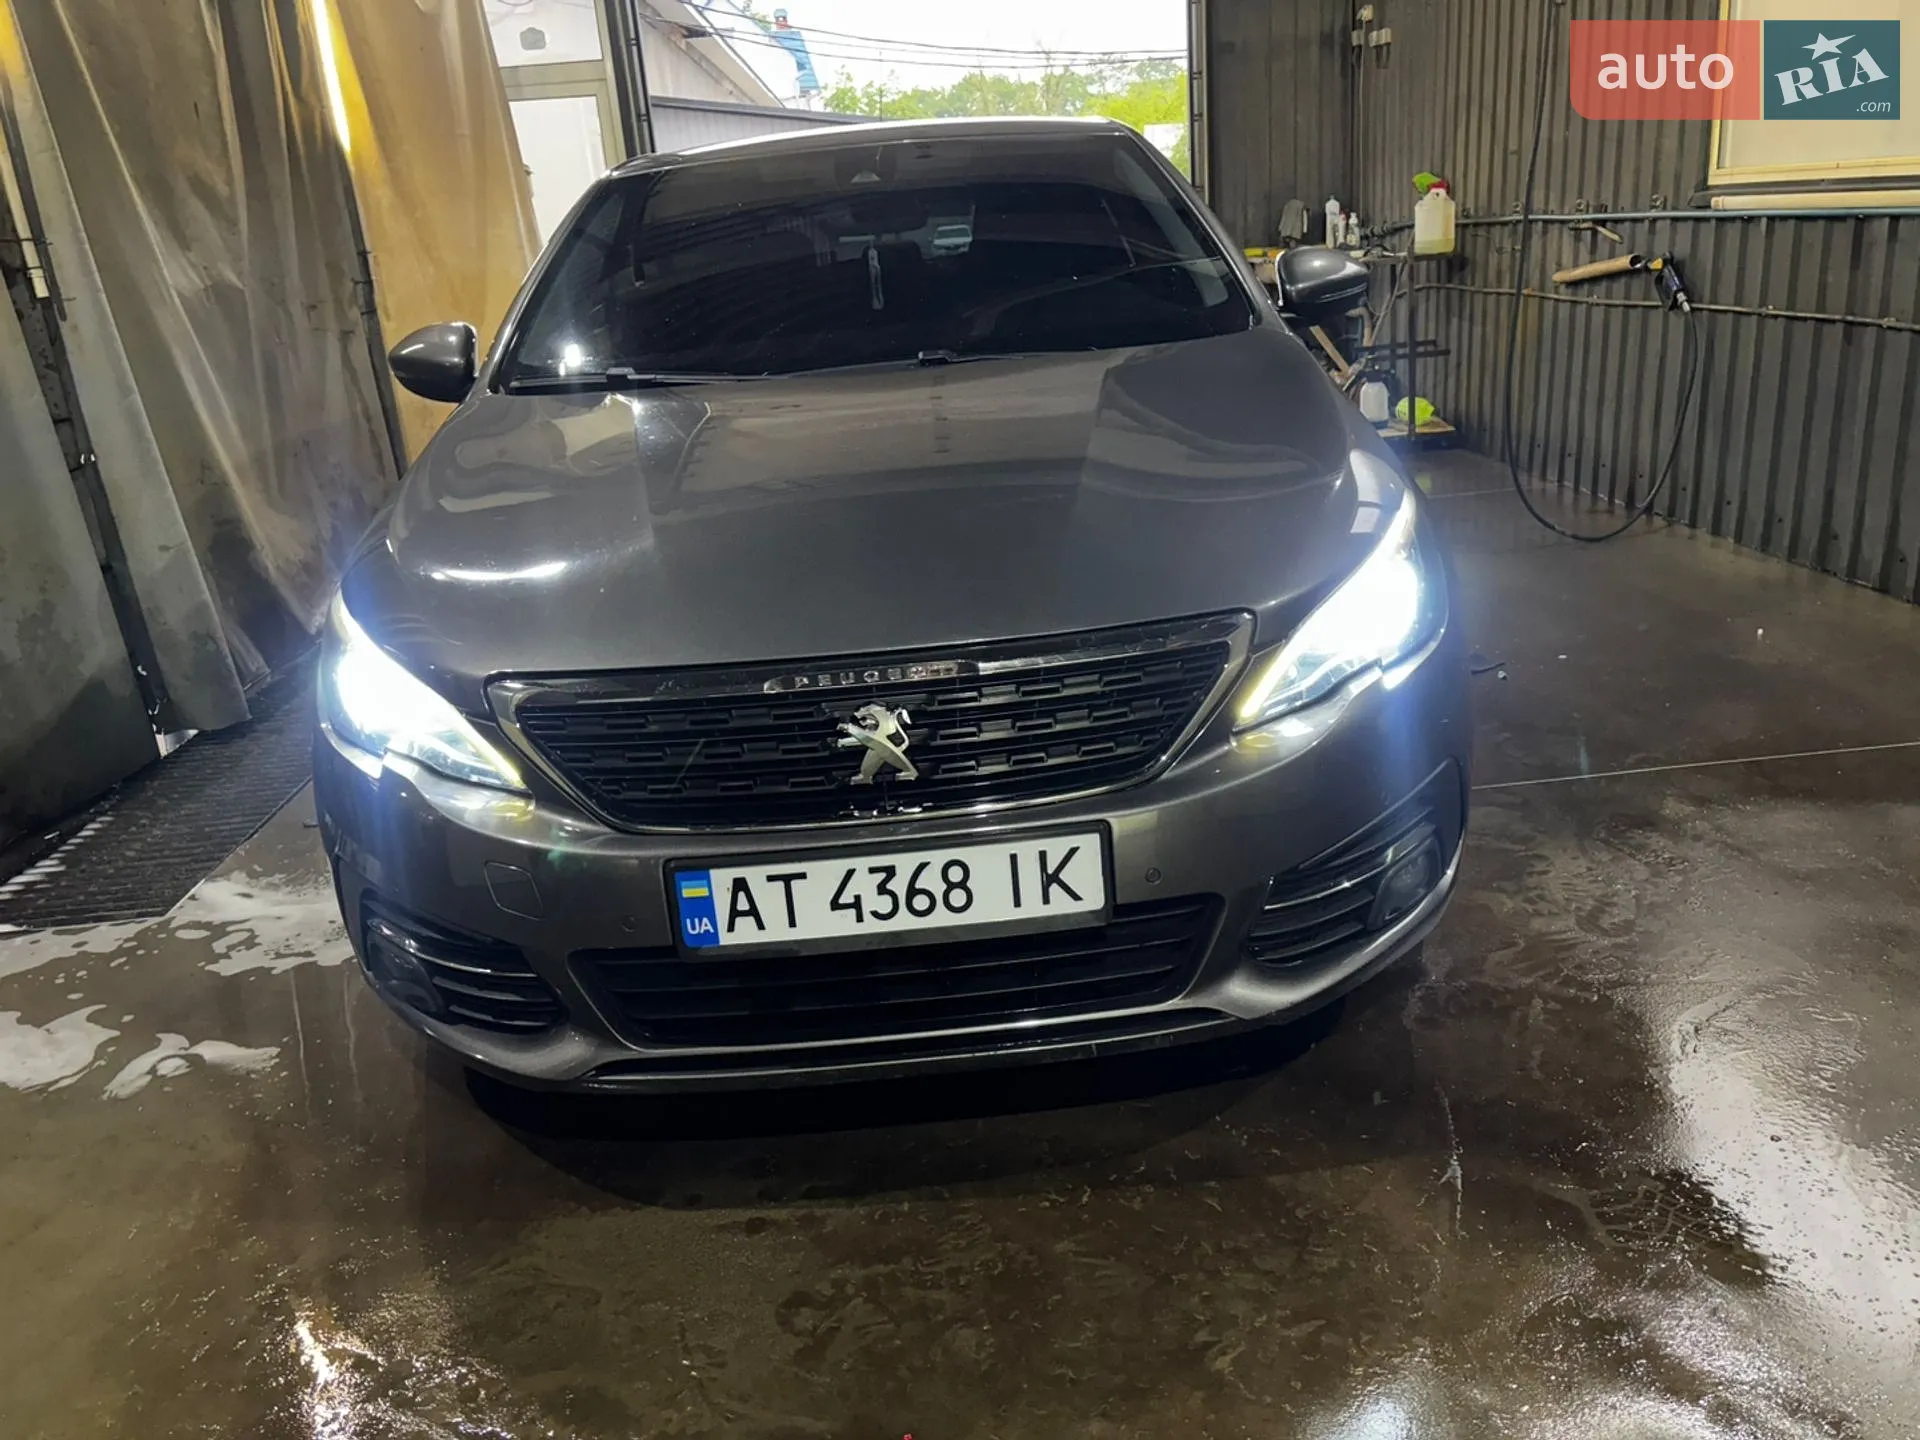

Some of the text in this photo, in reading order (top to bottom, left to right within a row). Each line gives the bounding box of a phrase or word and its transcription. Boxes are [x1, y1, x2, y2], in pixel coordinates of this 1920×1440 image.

[726, 846, 1084, 933] AT 4368 IK
[686, 918, 715, 936] UA
